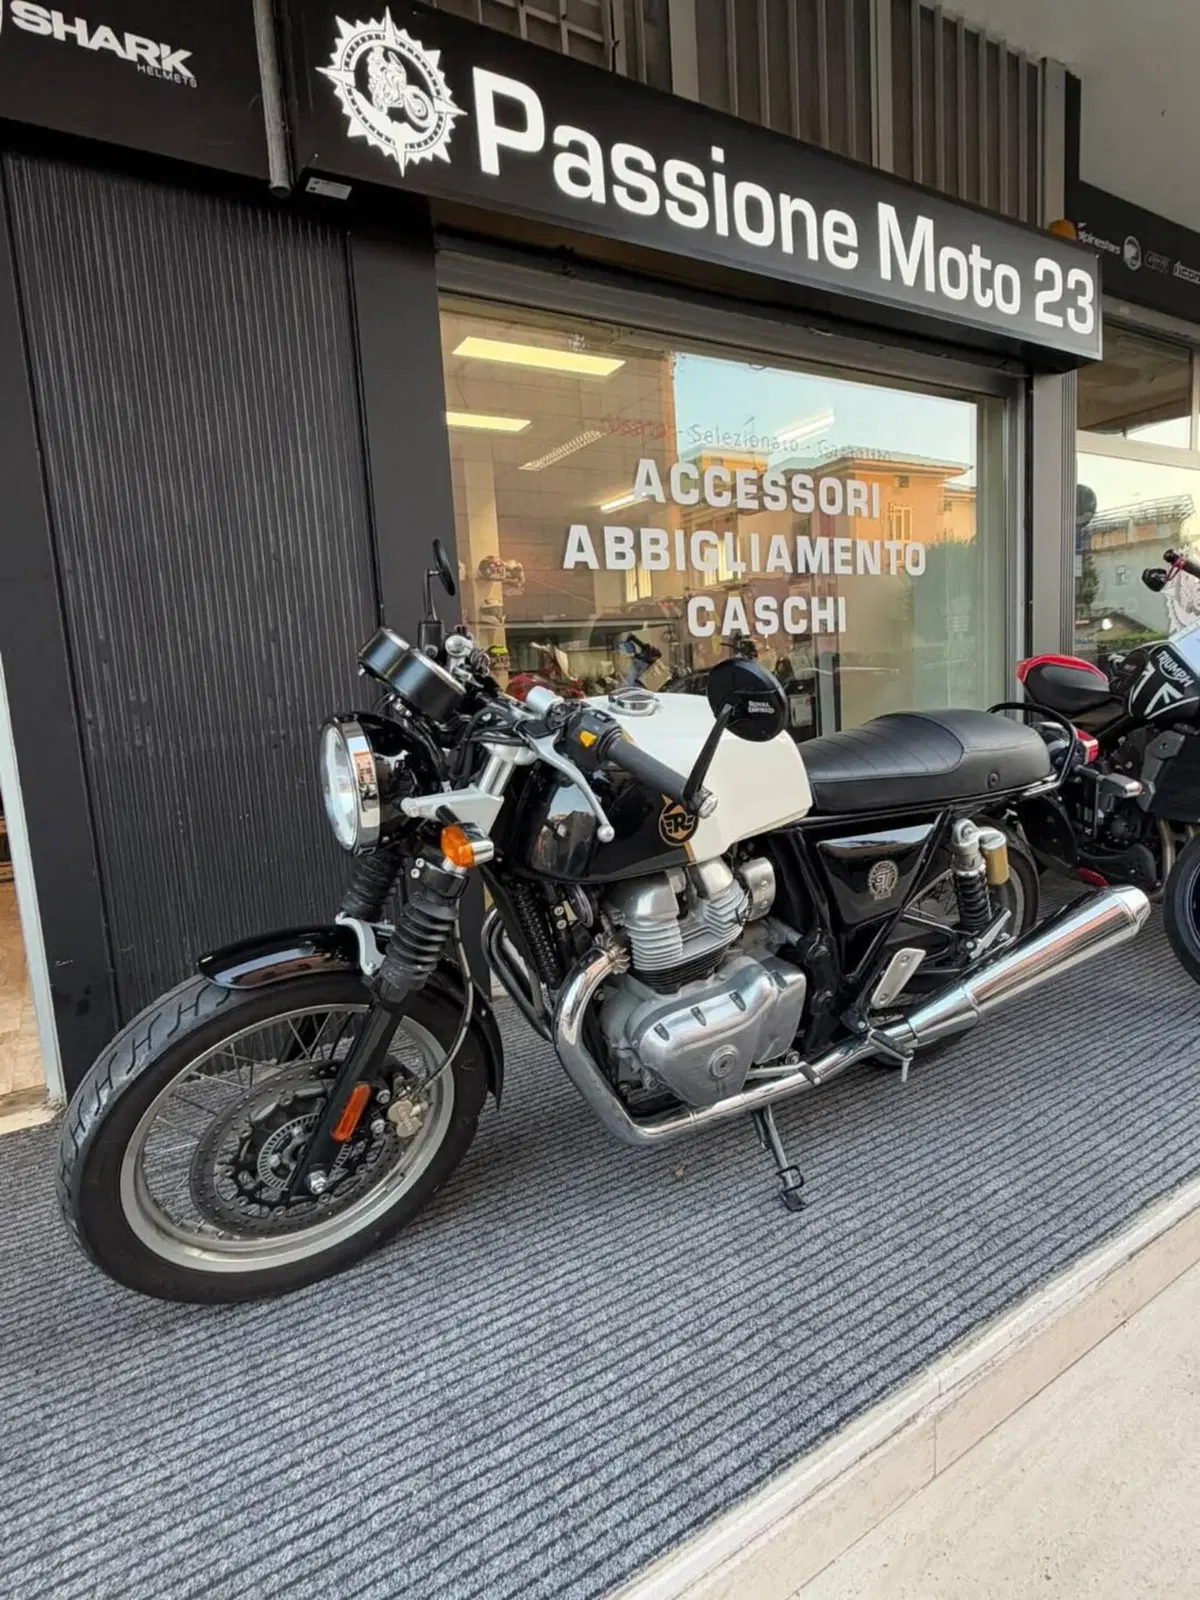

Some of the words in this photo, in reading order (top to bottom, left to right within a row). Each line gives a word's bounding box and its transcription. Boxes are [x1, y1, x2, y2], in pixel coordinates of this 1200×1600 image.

[10, 0, 195, 78] SHARK
[136, 63, 198, 88] HELMETS
[473, 67, 859, 271] Passione
[878, 202, 1021, 315] Moto
[1034, 257, 1094, 335] 23
[633, 458, 880, 518] ACCESSORI
[563, 524, 926, 577] ABBIGLIAMENTO
[687, 595, 847, 638] CASCHI
[1156, 650, 1195, 688] TRIUMPH
